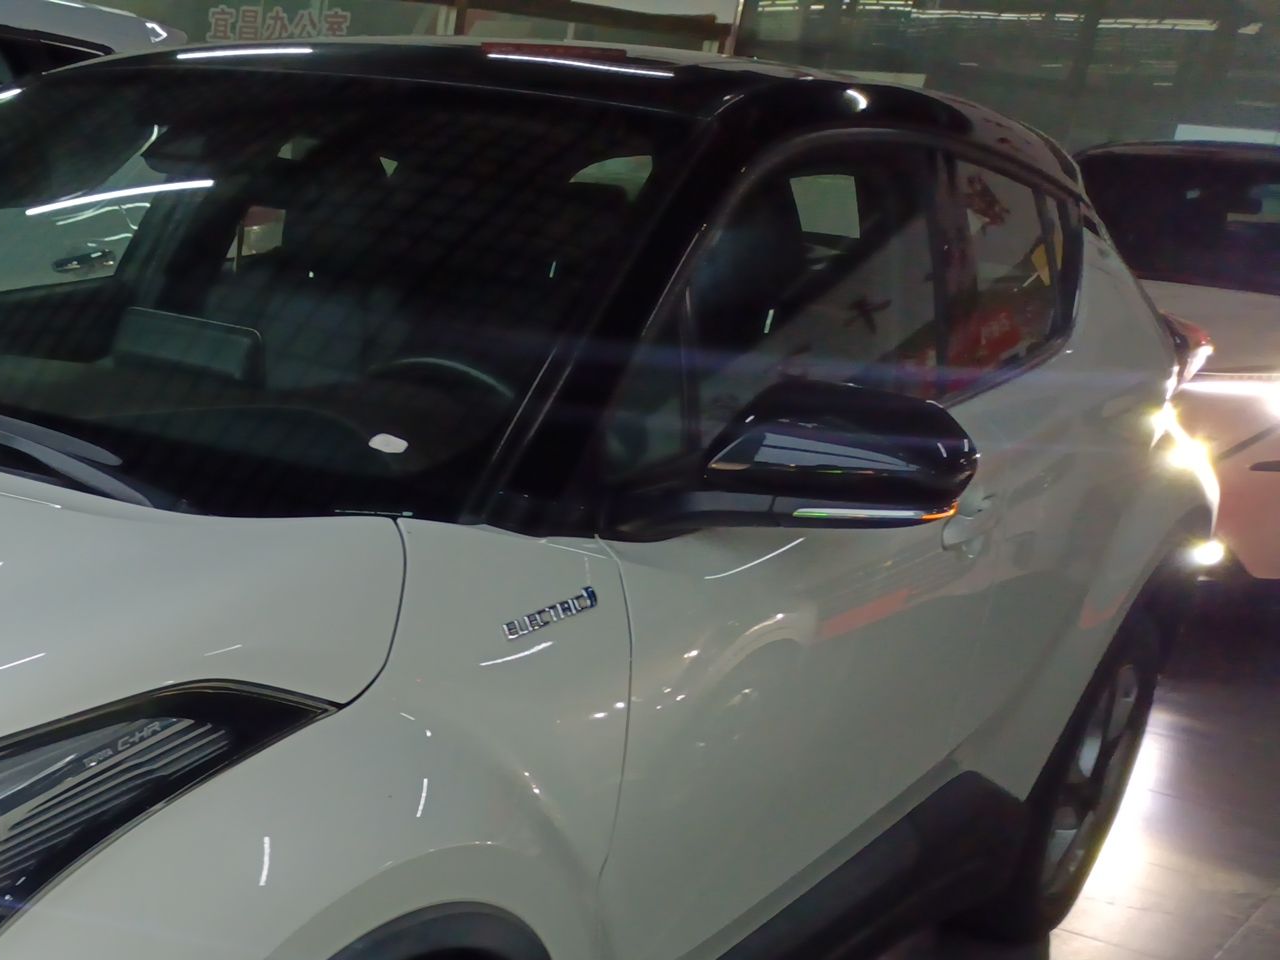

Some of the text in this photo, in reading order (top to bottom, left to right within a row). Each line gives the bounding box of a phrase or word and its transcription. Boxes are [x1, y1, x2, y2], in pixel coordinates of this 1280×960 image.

[207, 5, 350, 41] 宜昌办公室
[502, 587, 597, 640] ELECTRIC
[117, 721, 162, 751] C-HR
